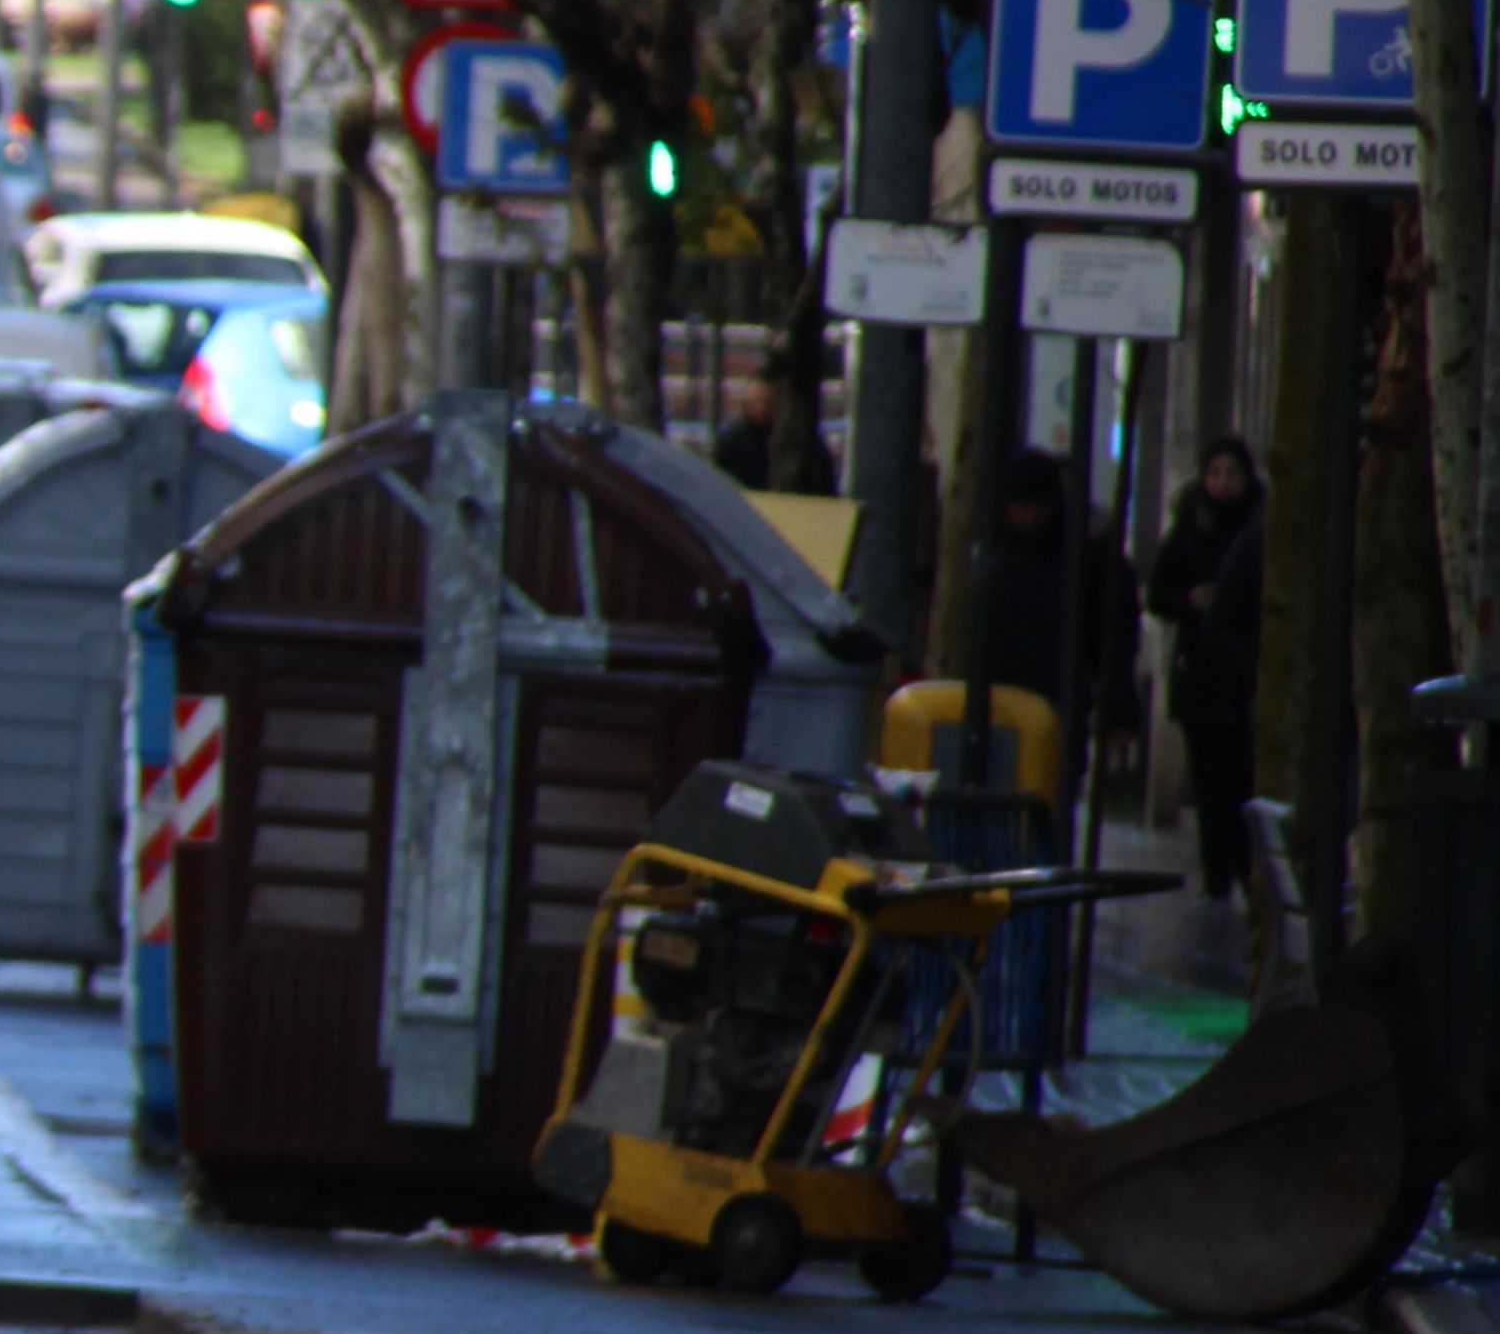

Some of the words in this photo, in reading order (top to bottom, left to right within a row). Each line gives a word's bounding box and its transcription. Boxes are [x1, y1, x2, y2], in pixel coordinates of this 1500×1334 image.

[467, 55, 559, 172] P
[1261, 139, 1337, 165] SOLO
[1358, 142, 1417, 167] MOT
[1010, 175, 1077, 197] SOLO
[1092, 179, 1178, 204] MOTOS
